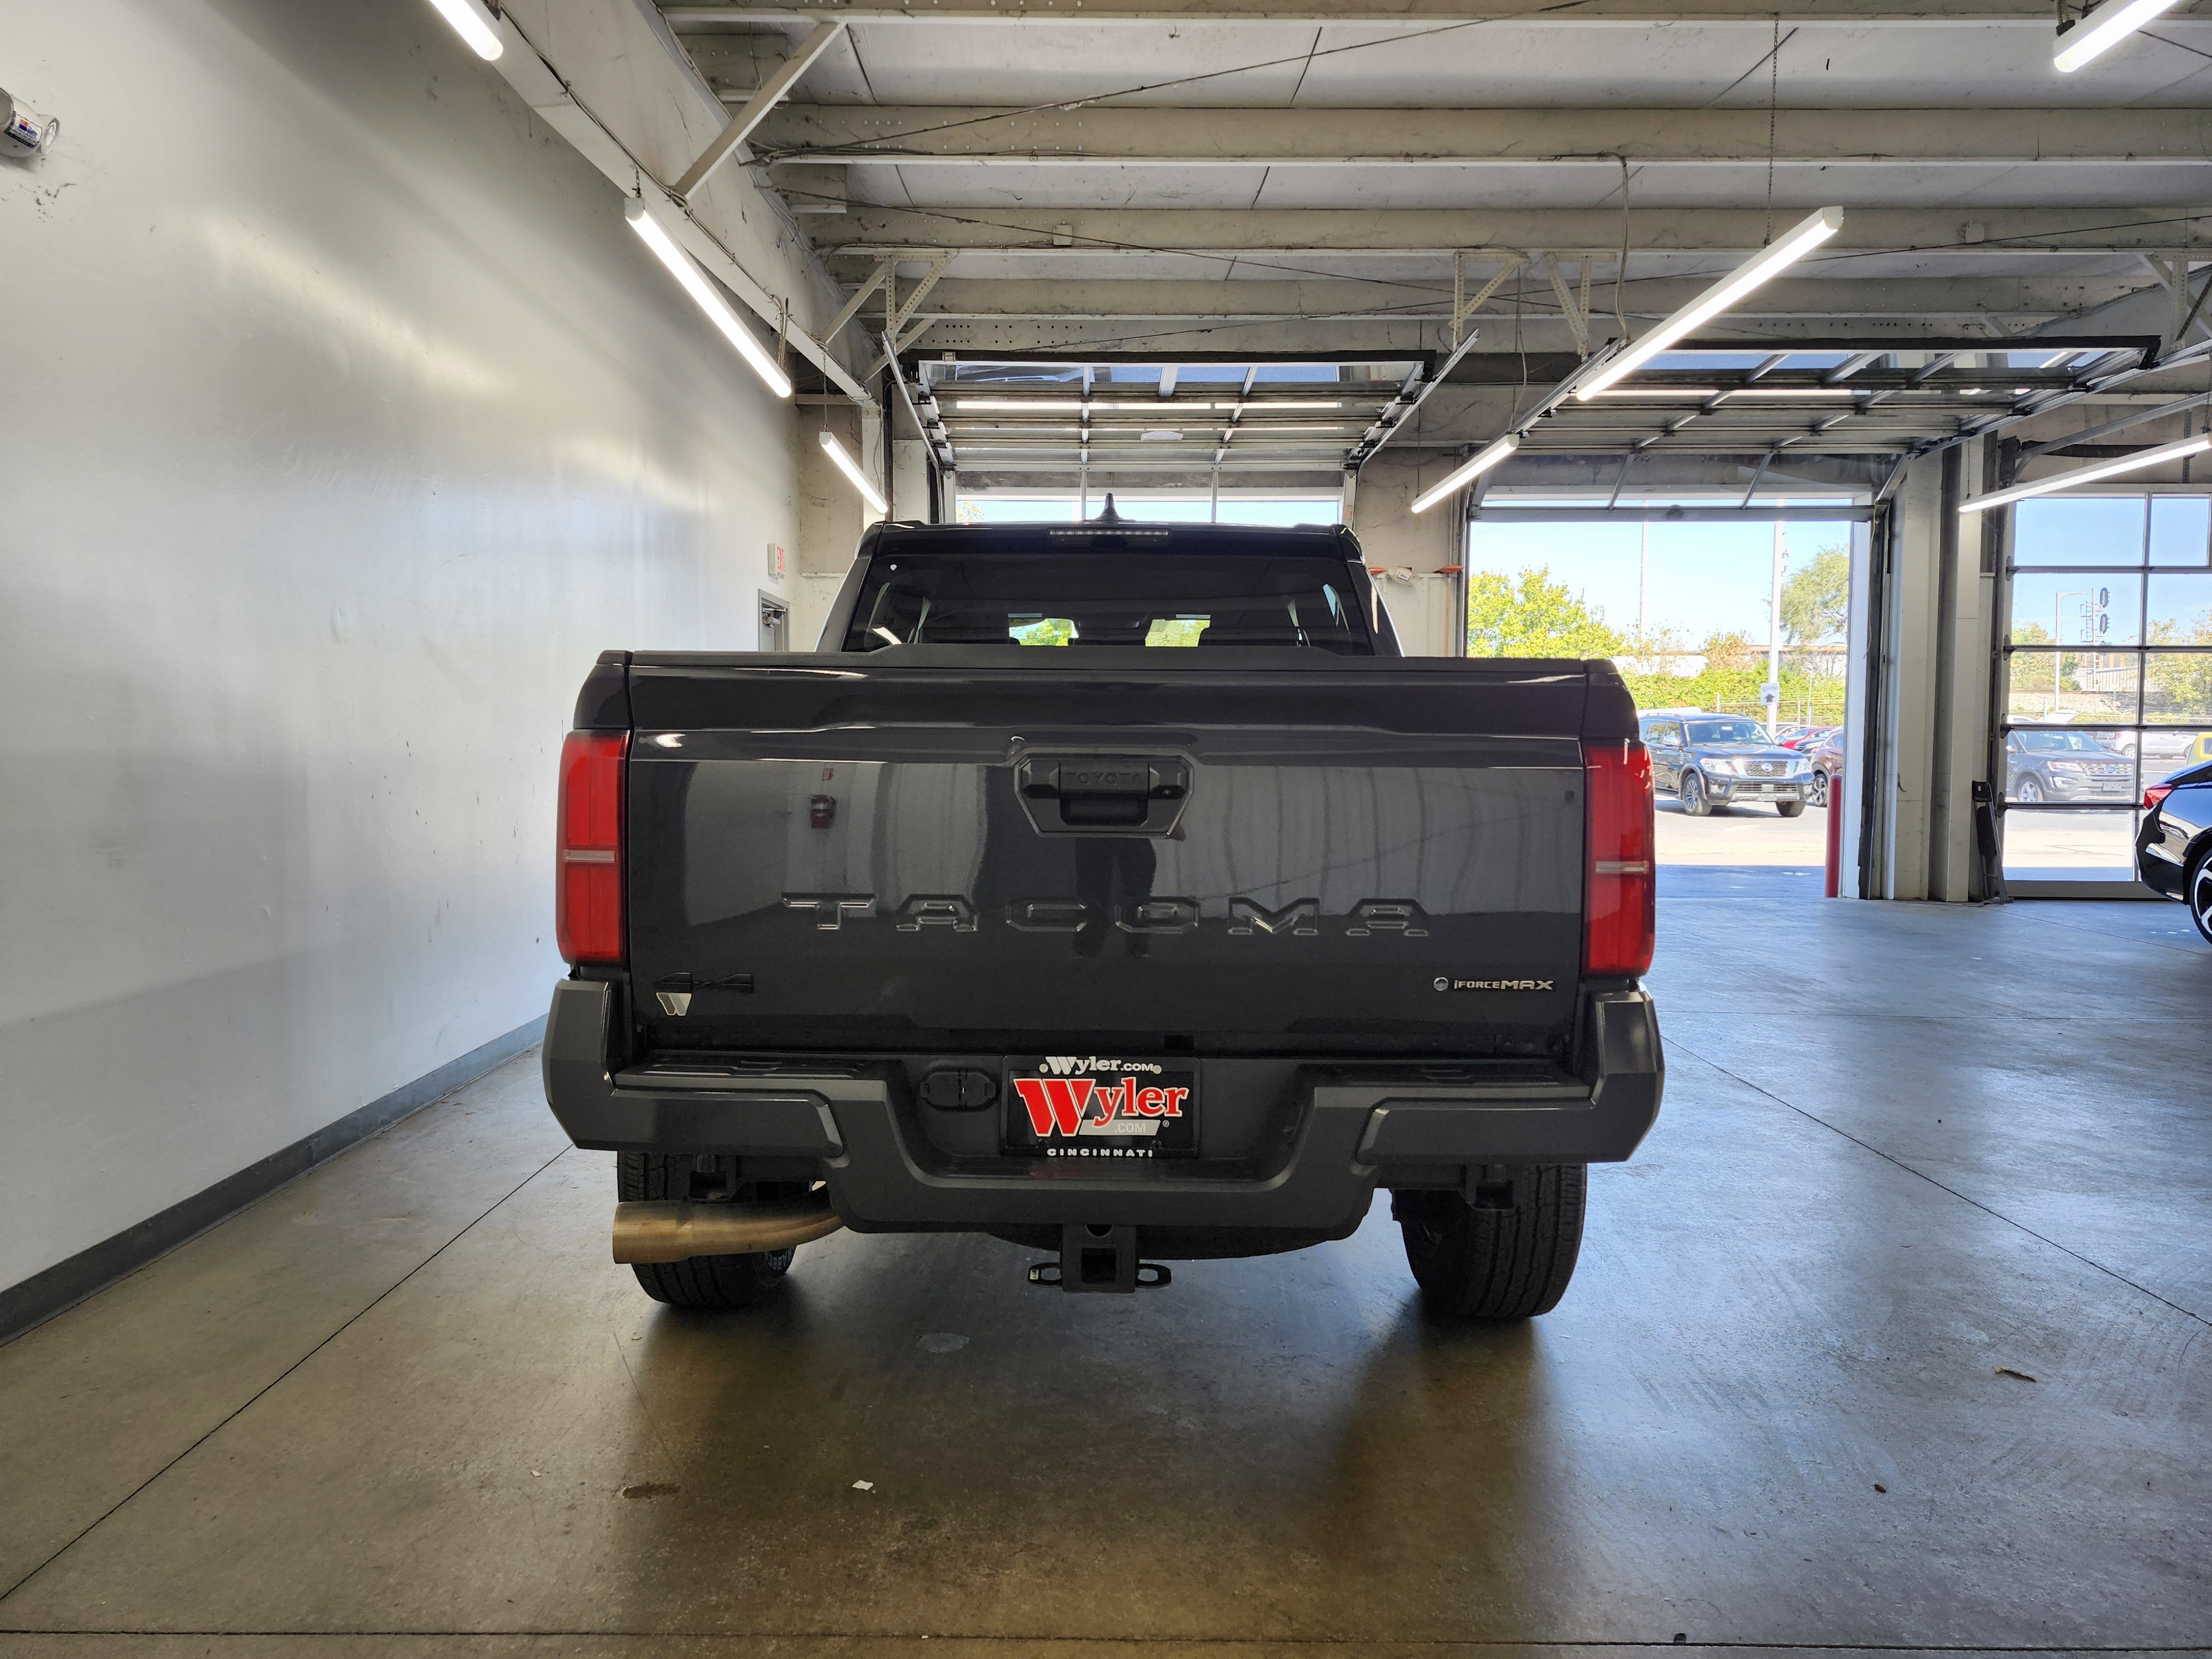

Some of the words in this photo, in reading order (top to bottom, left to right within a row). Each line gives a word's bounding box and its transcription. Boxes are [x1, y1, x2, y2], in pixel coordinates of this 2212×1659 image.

[781, 893, 1430, 936] TACOMA
[1013, 1076, 1189, 1137] Wyler
[1046, 1148, 1153, 1157] CINCINNATI
